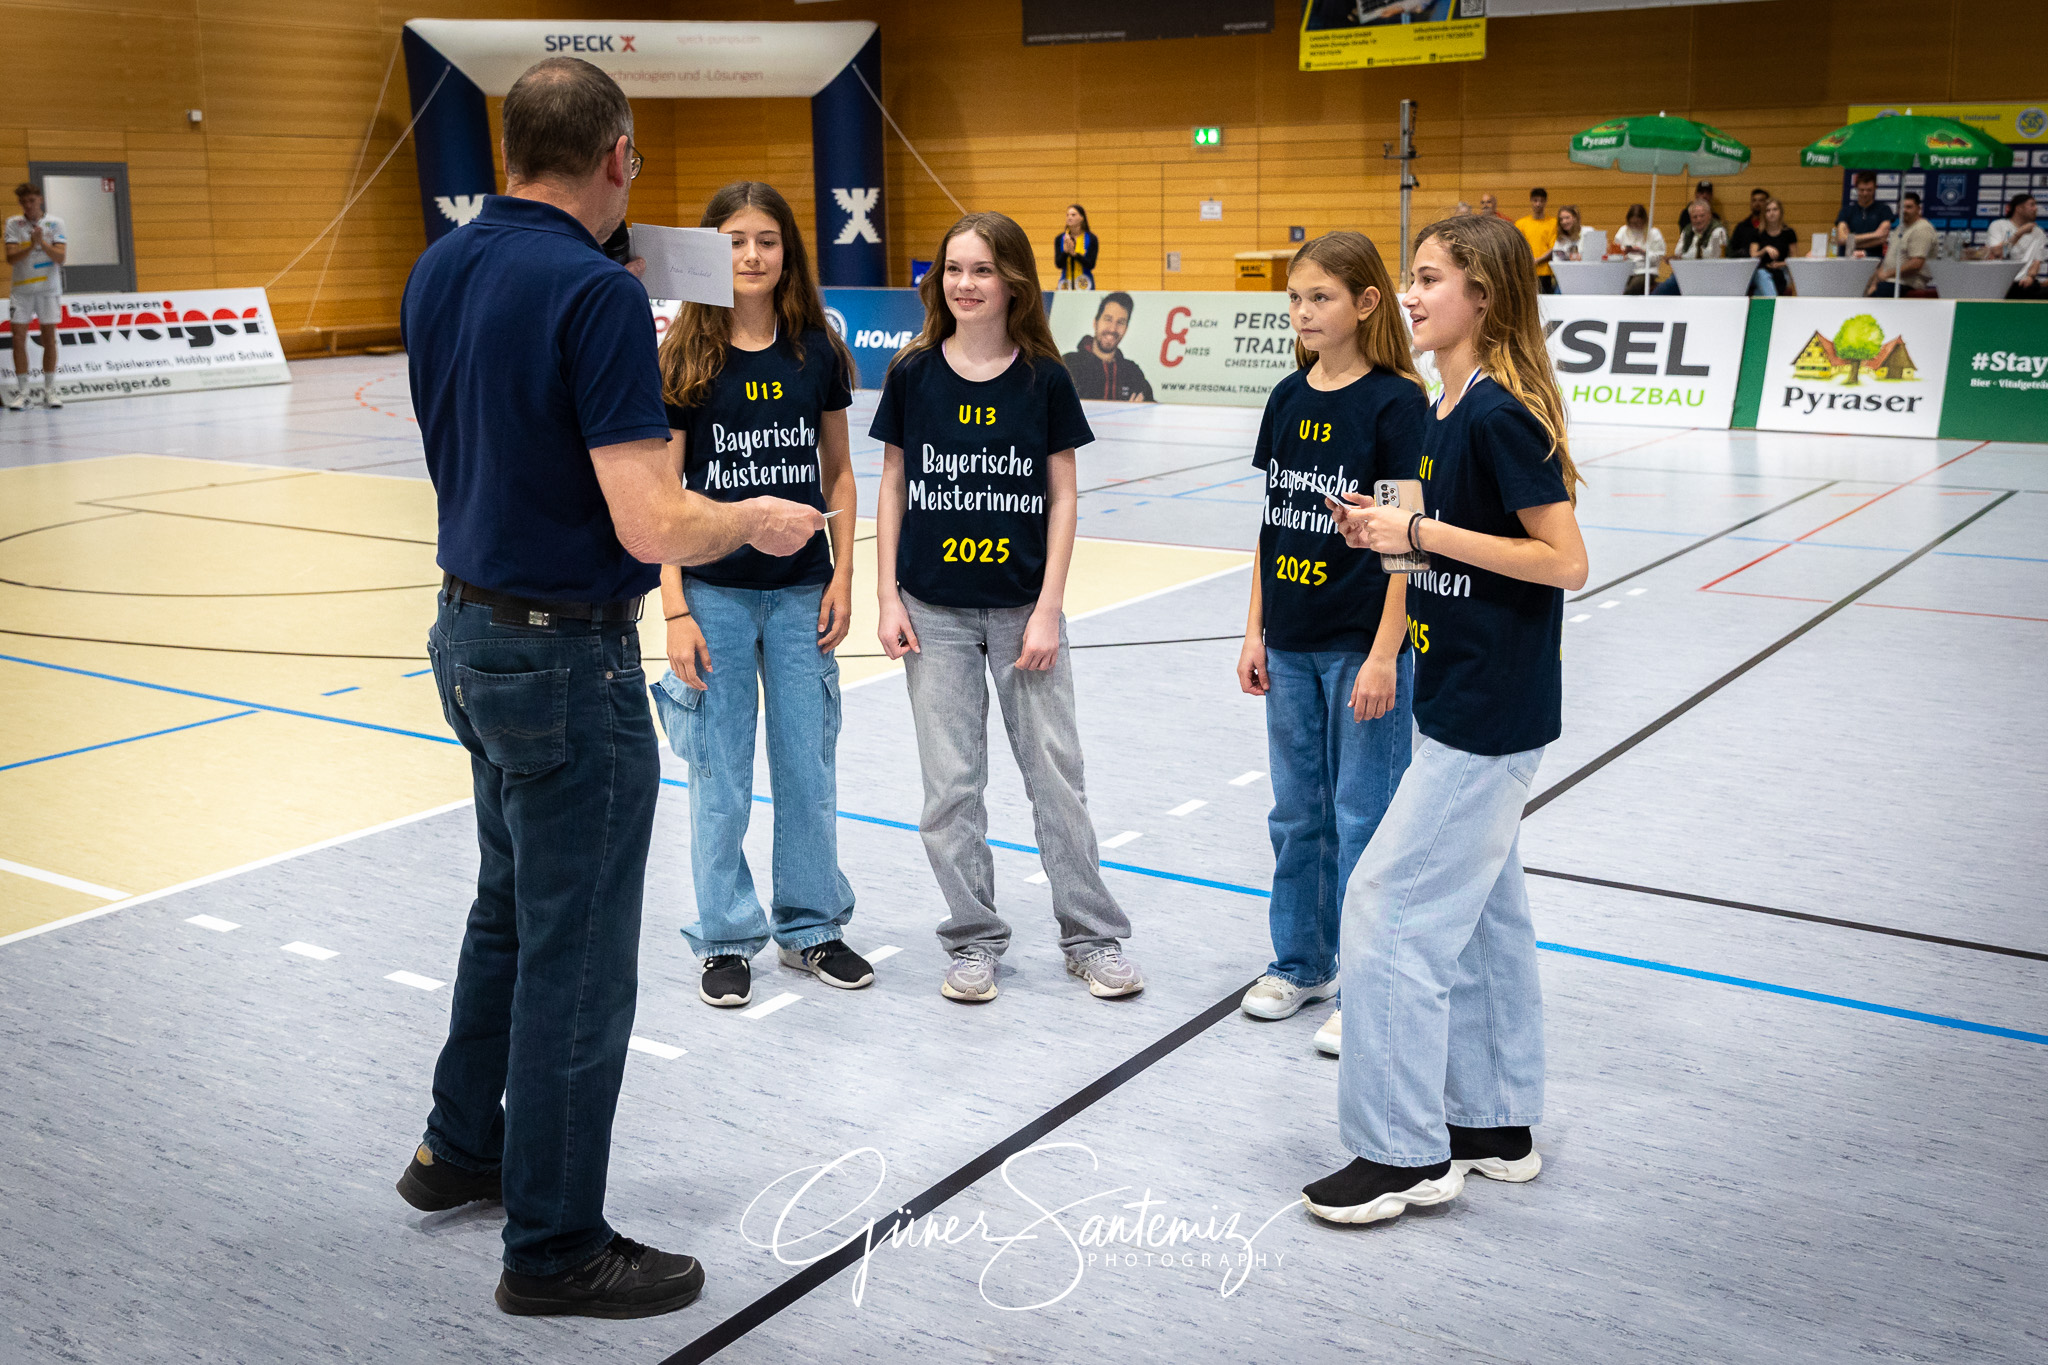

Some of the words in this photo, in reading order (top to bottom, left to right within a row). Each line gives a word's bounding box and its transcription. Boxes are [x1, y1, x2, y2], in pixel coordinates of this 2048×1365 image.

[544, 34, 615, 52] SPECK
[678, 69, 701, 81] und
[1582, 135, 1618, 149] Pyraser
[1930, 154, 1979, 167] Pyraser
[71, 300, 161, 315] Spielwaren
[854, 330, 913, 349] HOME
[1546, 319, 1711, 377] SEL
[175, 354, 212, 367] Hobby
[215, 353, 236, 363] und
[238, 349, 275, 360] Schule
[1225, 358, 1286, 369] CHRISTIAN
[745, 381, 784, 400] U13
[1970, 378, 1991, 388] Bier
[1572, 384, 1706, 407] HOLZBAU
[1782, 386, 1923, 415] Pyraser
[958, 404, 997, 426] U13
[712, 416, 816, 458] Bayerische
[1299, 419, 1332, 442] U13
[922, 443, 1034, 481] Bayerische
[908, 479, 1044, 514] Meisterinnen
[942, 537, 1011, 564] 2025
[1276, 554, 1328, 586] 2025
